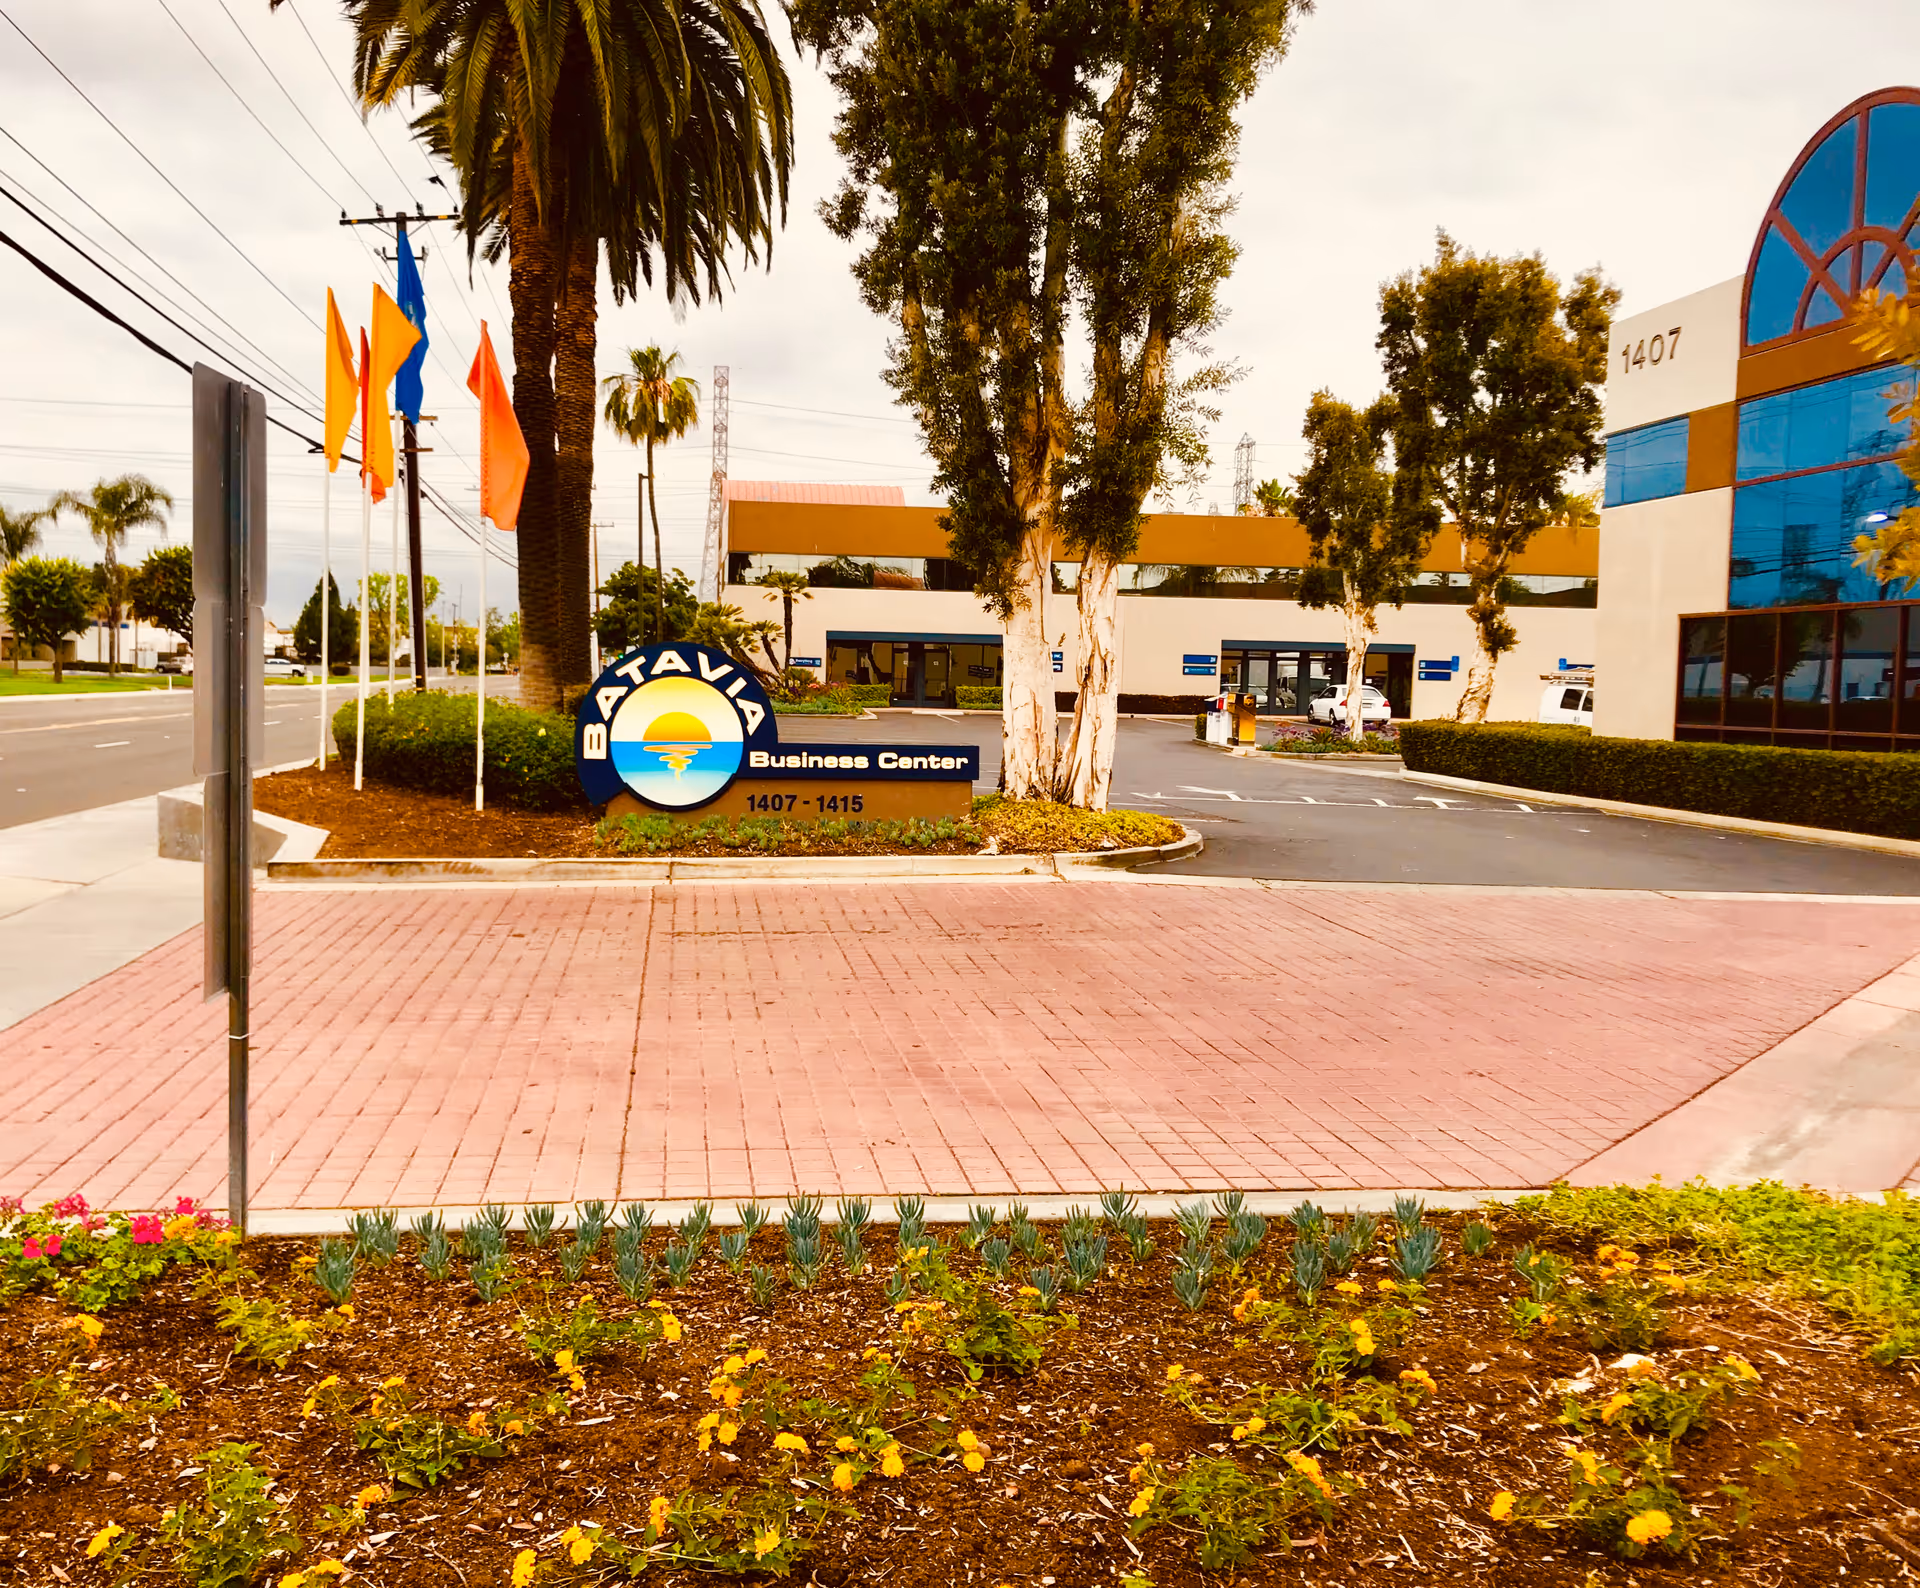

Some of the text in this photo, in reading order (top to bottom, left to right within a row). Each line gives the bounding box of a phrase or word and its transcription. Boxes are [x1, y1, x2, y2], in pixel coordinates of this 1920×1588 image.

[1621, 326, 1682, 374] 1407
[583, 650, 766, 760] BATAVIA
[749, 751, 969, 770] Business Center
[747, 794, 798, 812] 1407
[816, 795, 864, 813] 1415
